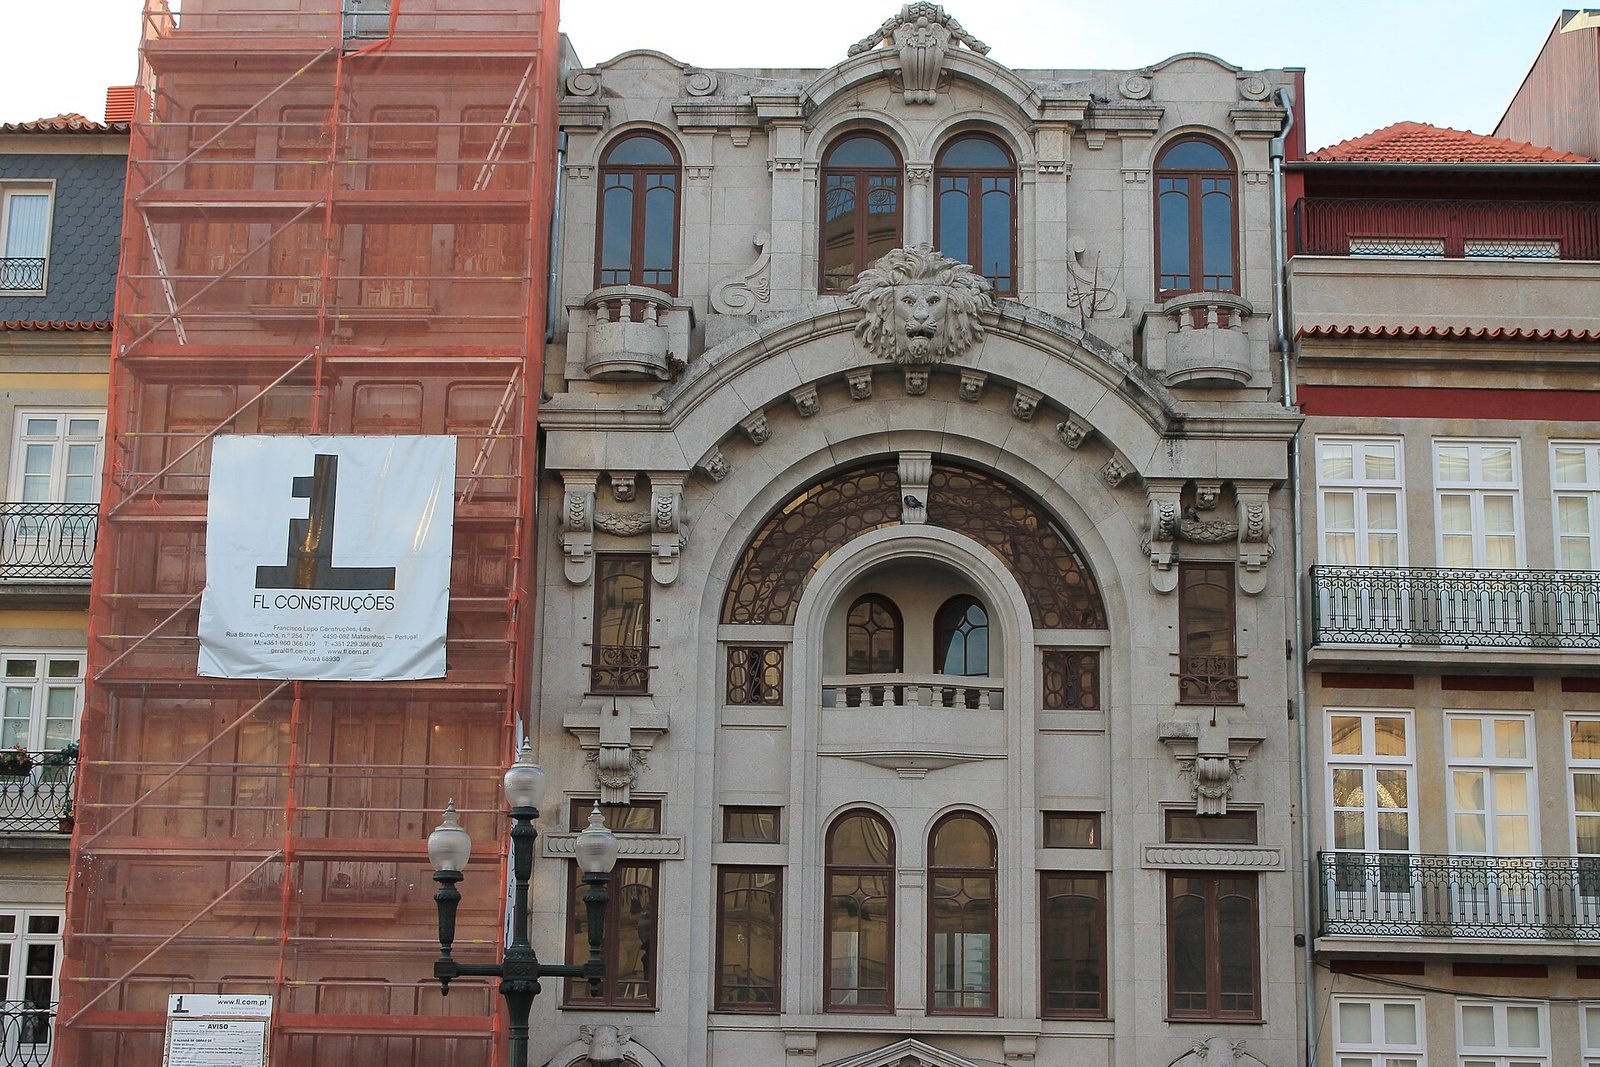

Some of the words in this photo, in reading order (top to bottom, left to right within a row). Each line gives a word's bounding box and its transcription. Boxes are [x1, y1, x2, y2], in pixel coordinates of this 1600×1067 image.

[252, 594, 270, 609] FL
[274, 593, 395, 614] CONSTRUÇÕES
[217, 998, 267, 1006] www.fl.com.pt
